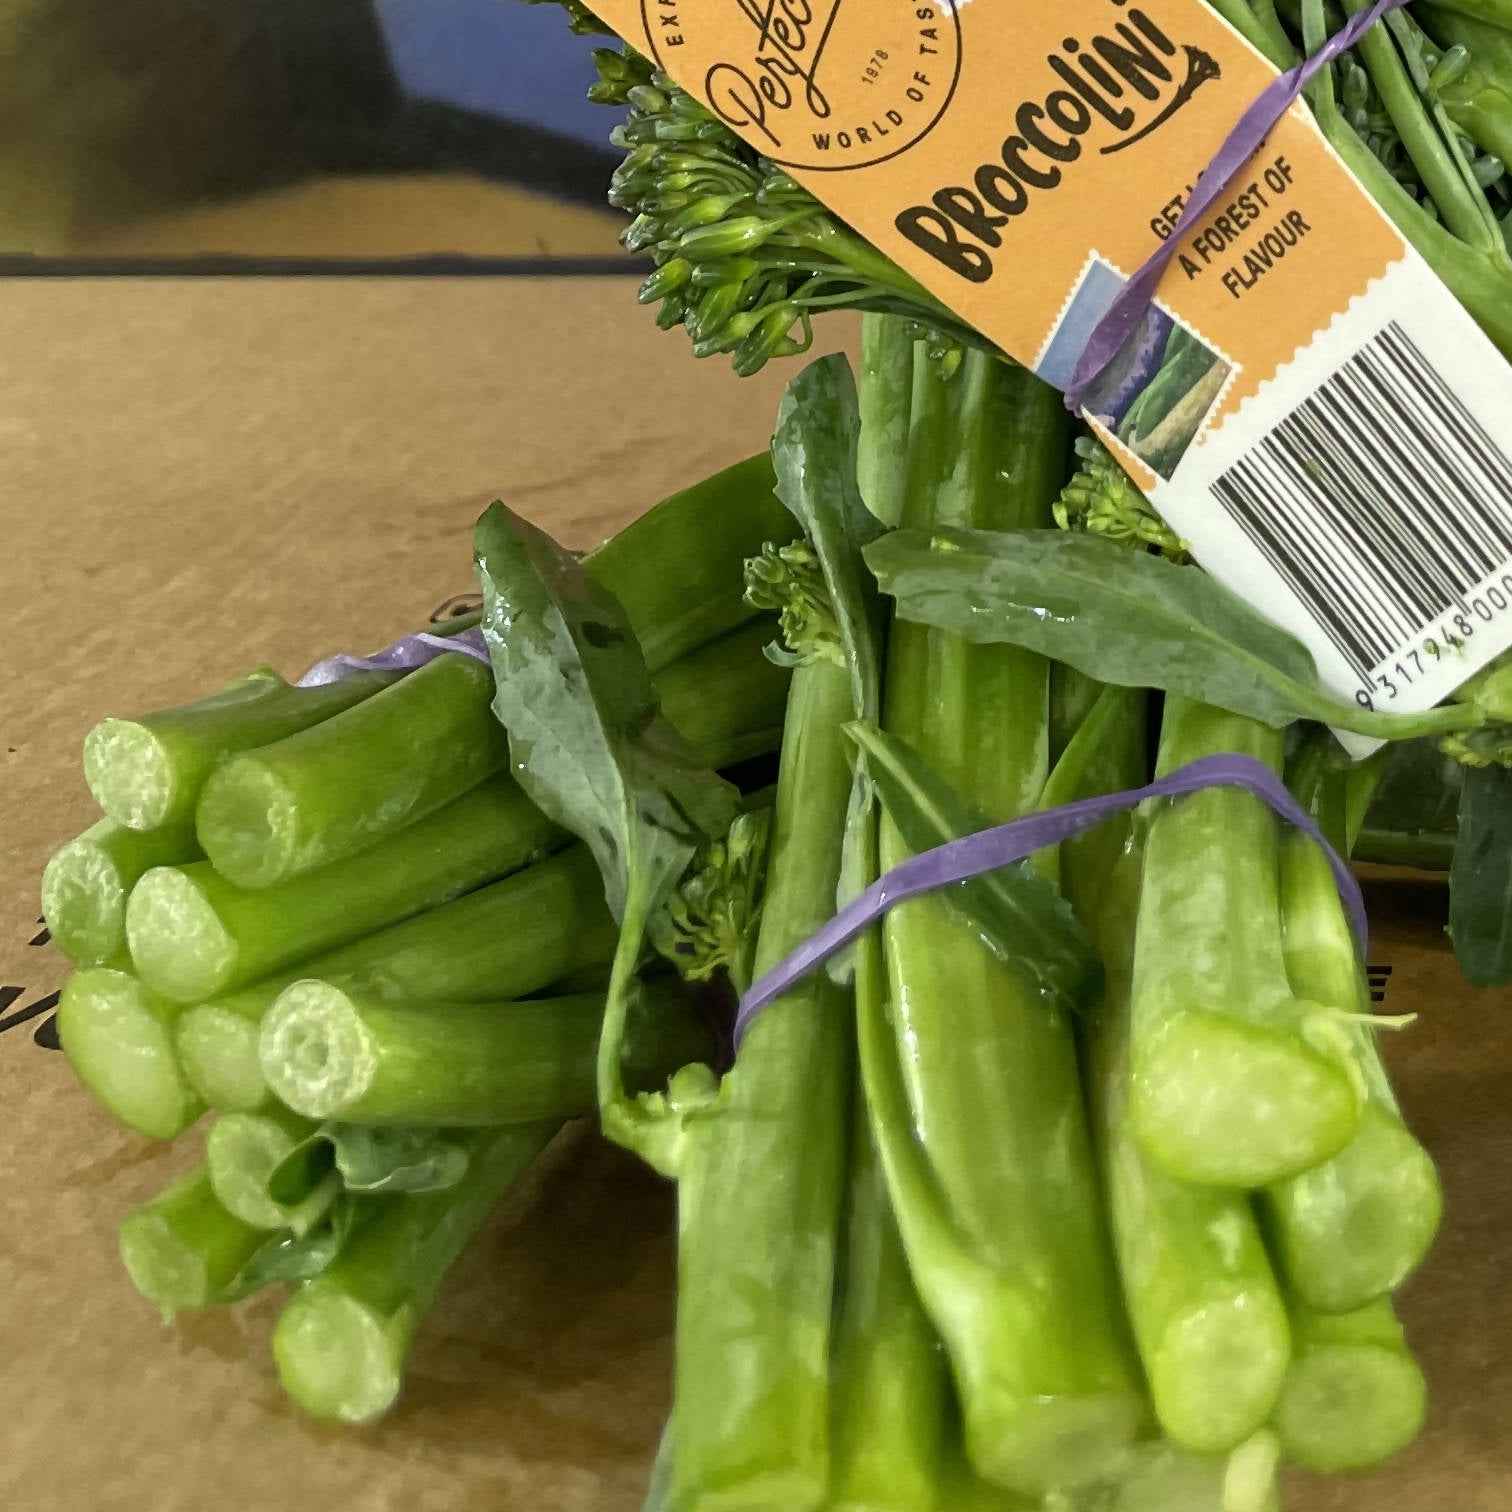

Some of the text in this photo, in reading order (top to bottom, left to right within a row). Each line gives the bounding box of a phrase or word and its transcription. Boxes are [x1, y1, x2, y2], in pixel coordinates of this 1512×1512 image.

[811, 108, 903, 151] WORLD
[905, 71, 931, 103] OF
[1177, 155, 1294, 281] A FOREST OF
[1220, 208, 1312, 299] FLAVOUR
